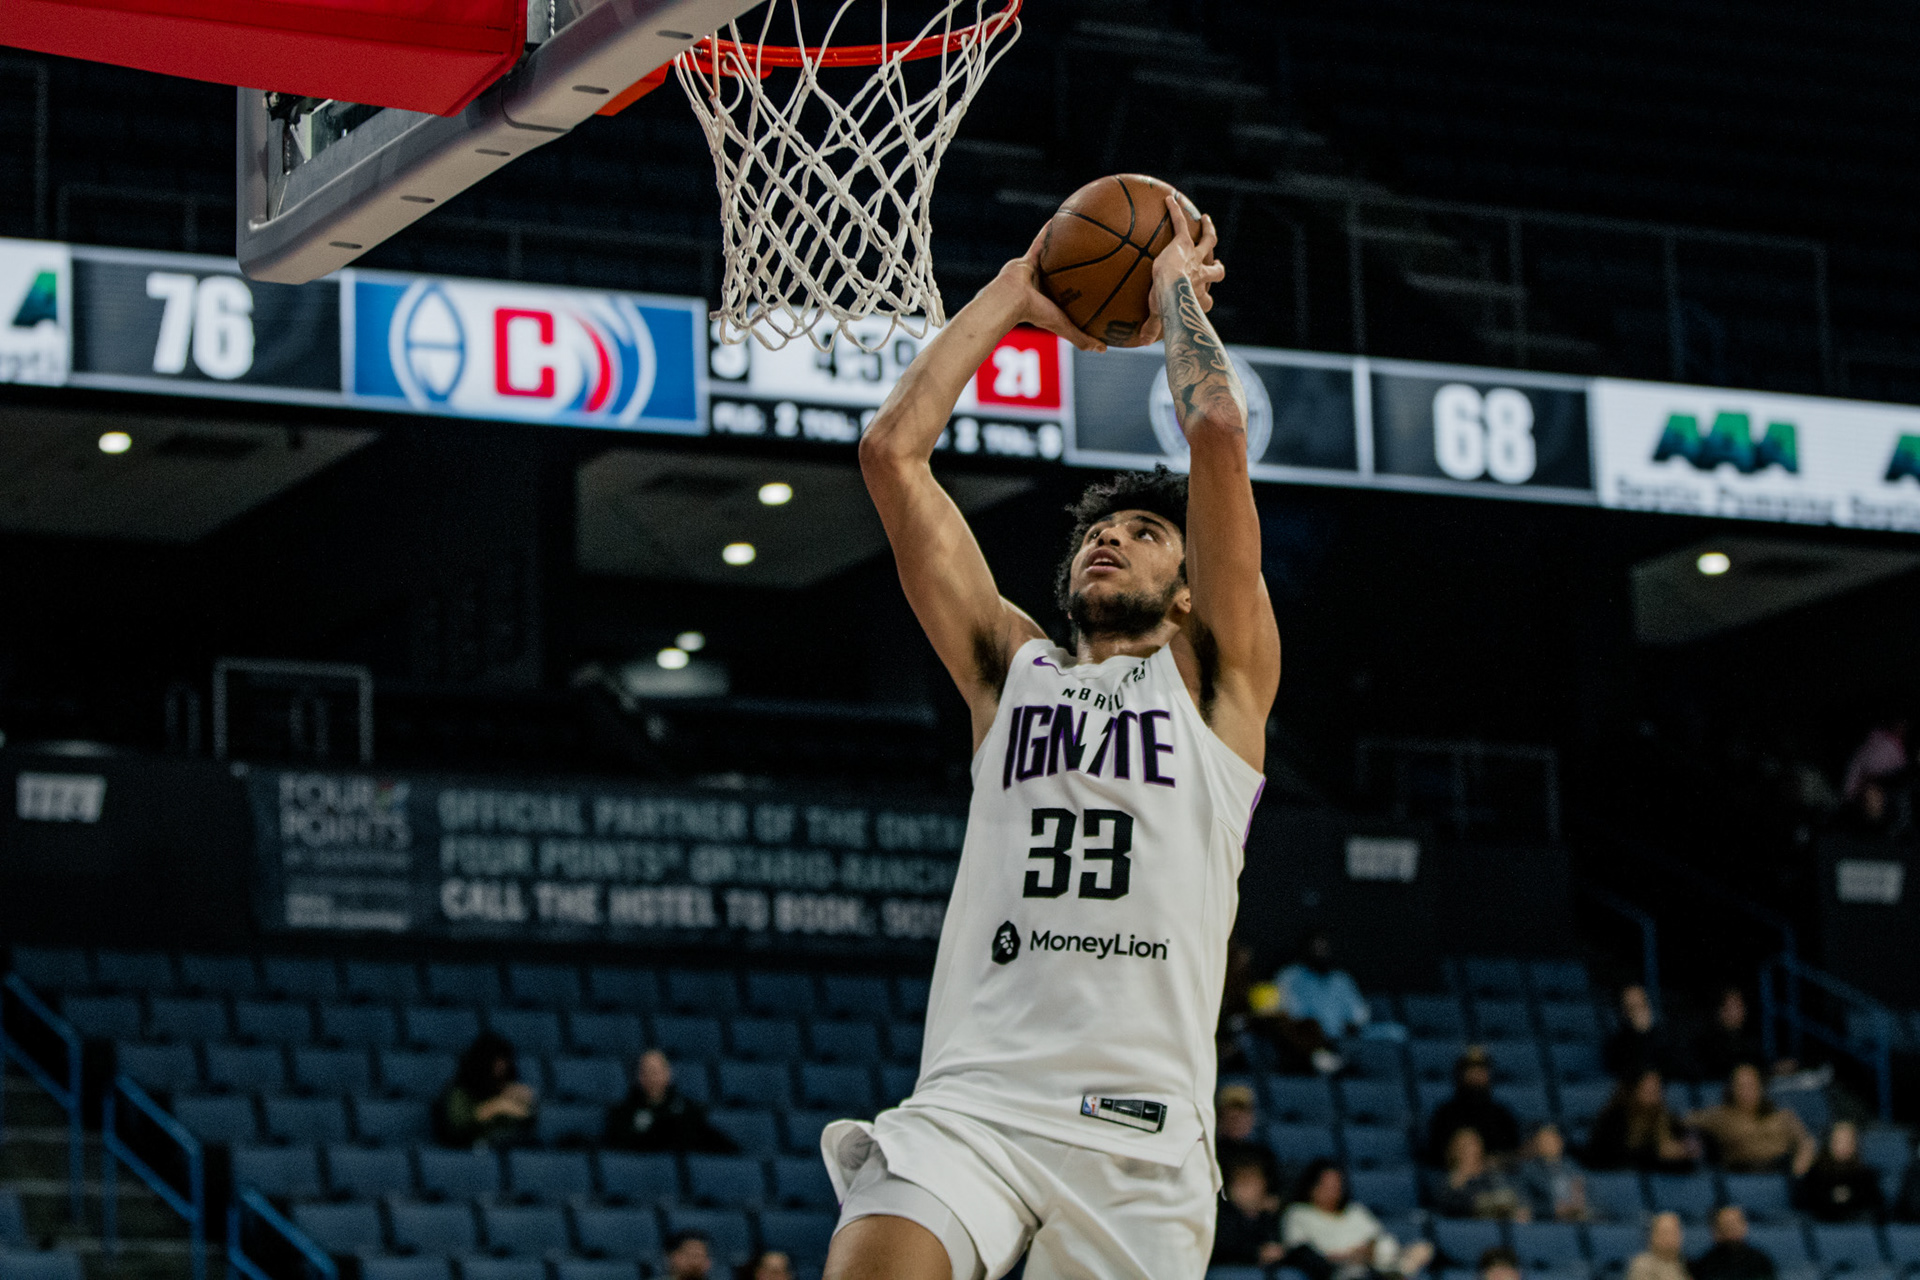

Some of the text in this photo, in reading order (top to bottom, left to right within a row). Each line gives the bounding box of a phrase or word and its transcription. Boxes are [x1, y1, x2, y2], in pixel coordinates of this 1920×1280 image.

[146, 271, 256, 379] 76
[992, 345, 1042, 398] 21
[1432, 384, 1537, 485] 68
[1003, 703, 1176, 791] IGNITE
[437, 788, 584, 835] OFFICIAL
[594, 797, 748, 839] PARTNER
[754, 803, 793, 838] OF
[807, 808, 866, 847] THE
[439, 836, 532, 878] FOUR
[1022, 807, 1135, 900] 33
[440, 878, 525, 924] CALL
[534, 882, 603, 926] THE
[608, 885, 716, 928] HOTEL
[725, 888, 768, 930] TO
[1029, 930, 1168, 960] MoneyLion
